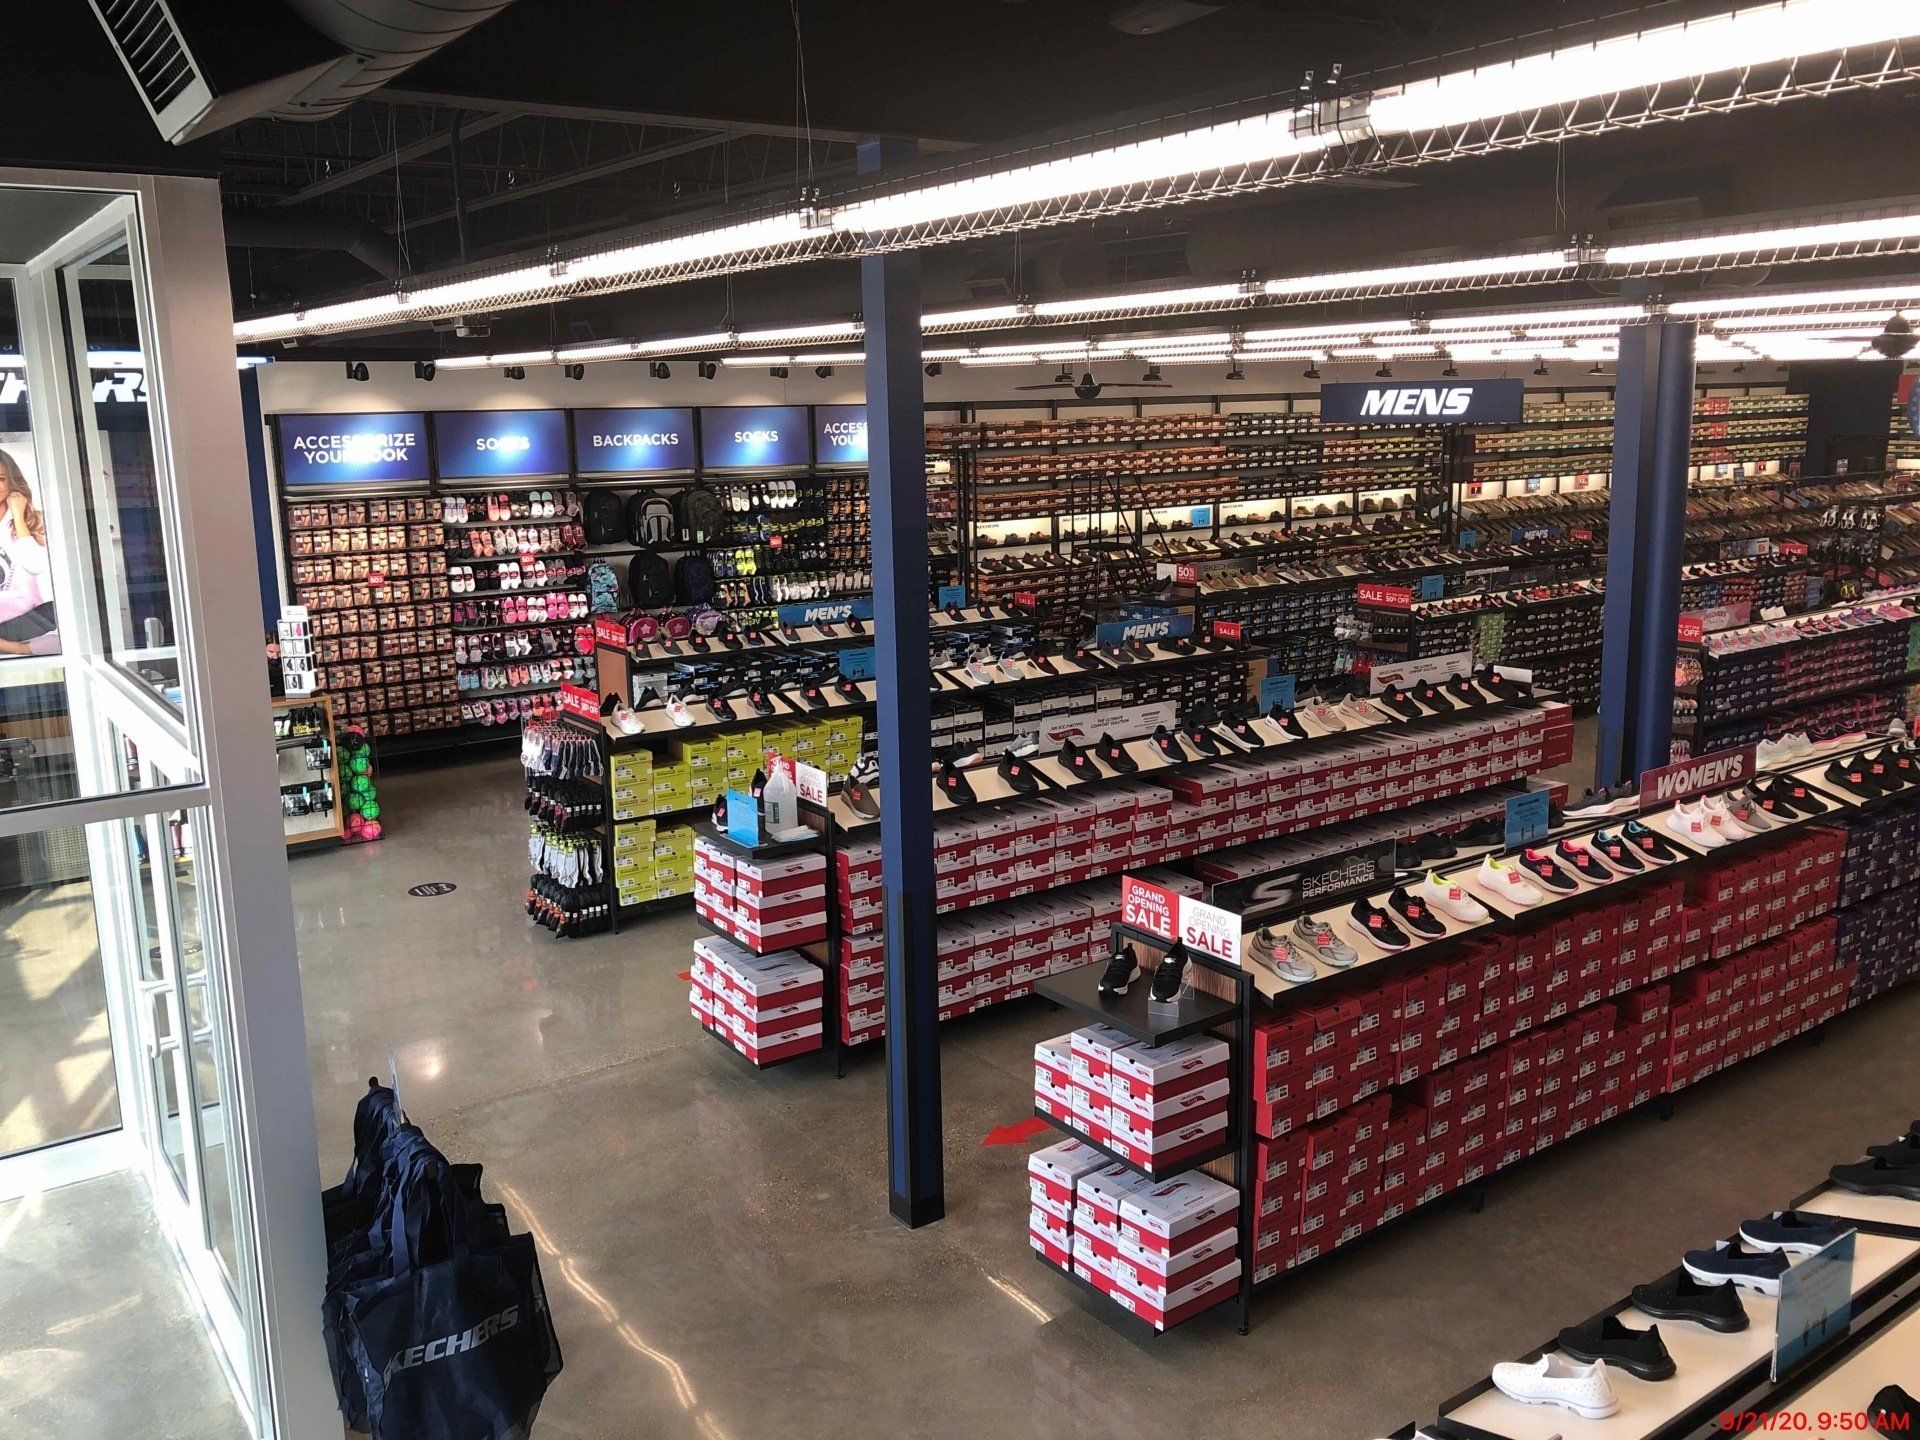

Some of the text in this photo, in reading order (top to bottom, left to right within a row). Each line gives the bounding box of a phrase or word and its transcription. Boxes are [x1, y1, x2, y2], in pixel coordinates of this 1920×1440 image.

[1360, 387, 1473, 415] MENS
[293, 433, 416, 449] ACCESRIZE
[593, 433, 679, 447] BACKPACKS
[734, 430, 779, 444] SOCKS
[1360, 590, 1383, 601] SALE
[805, 605, 852, 622] MEN'S
[596, 626, 611, 640] SALE
[1122, 621, 1170, 640] MEN'S
[1219, 628, 1235, 636] SALE
[1683, 629, 1700, 637] OFF
[563, 690, 580, 708] SALE
[1657, 754, 1744, 800] WOMEN'S
[800, 783, 823, 804] SALE
[1302, 860, 1375, 890] SKECHERS
[1131, 885, 1166, 905] GRAND
[1302, 872, 1375, 899] PERFORMANCE
[1127, 893, 1170, 917] OPENING
[1125, 903, 1171, 937] SALE
[1192, 906, 1227, 927] GRAND
[1188, 915, 1231, 939] OPENING
[1186, 926, 1233, 959] SALE
